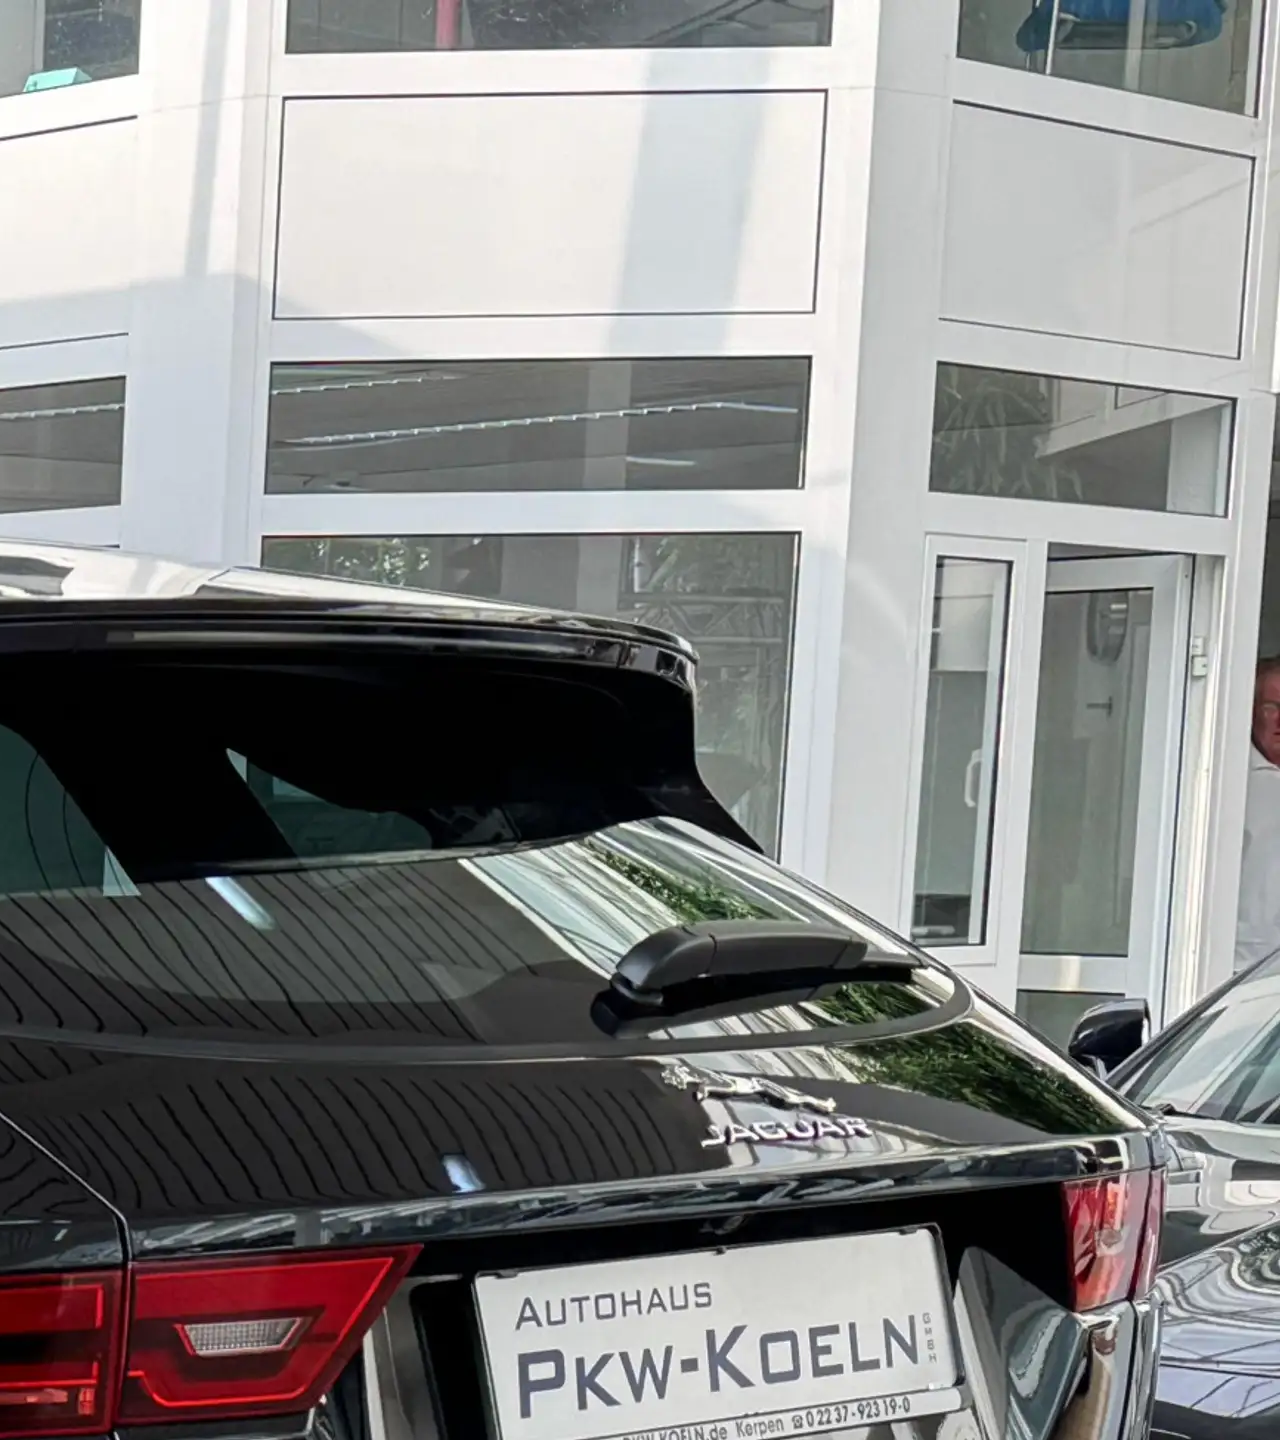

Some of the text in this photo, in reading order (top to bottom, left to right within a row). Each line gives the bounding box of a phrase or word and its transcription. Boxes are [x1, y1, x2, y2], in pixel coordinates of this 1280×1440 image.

[701, 1116, 873, 1149] JAGUAR
[515, 1281, 713, 1331] AUTOHAUS
[517, 1314, 920, 1419] PKW-KOELN
[735, 1417, 785, 1439] Kerpen
